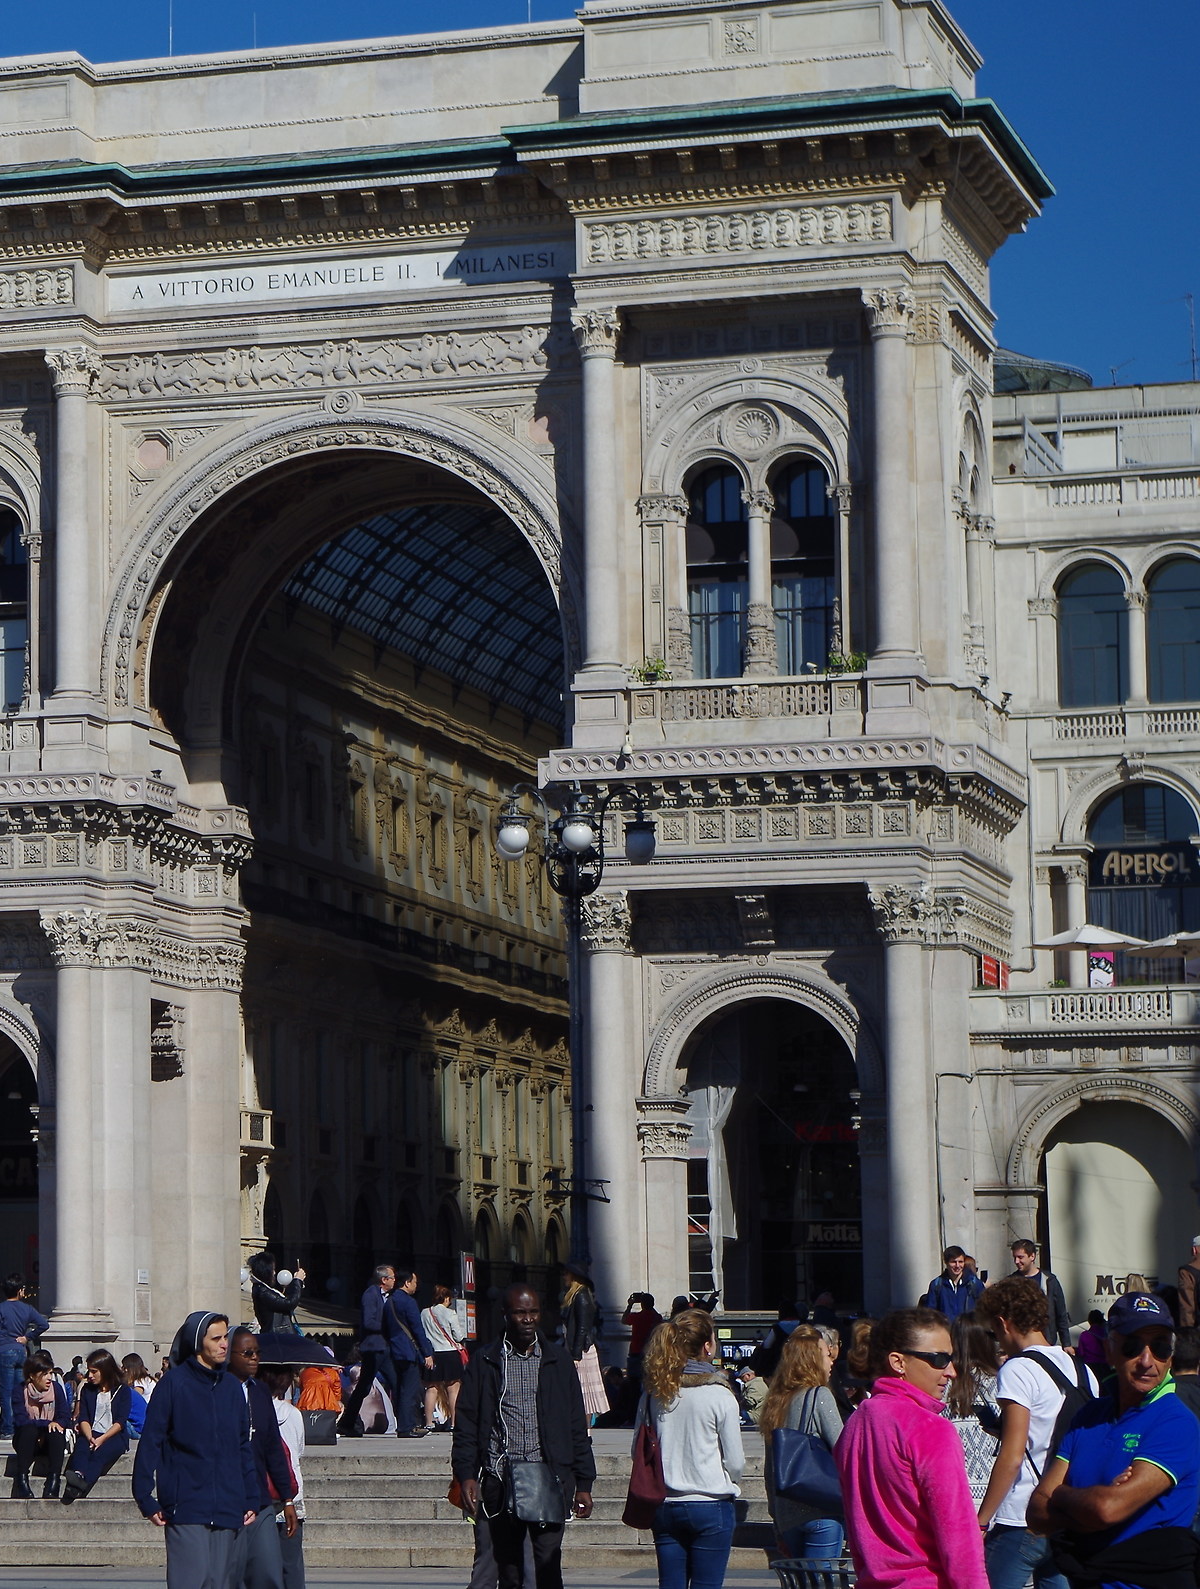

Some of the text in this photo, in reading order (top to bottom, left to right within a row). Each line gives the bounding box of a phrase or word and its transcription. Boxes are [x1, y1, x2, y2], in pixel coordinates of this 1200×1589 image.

[132, 285, 144, 299] A
[158, 276, 254, 297] VITTORIO
[268, 265, 384, 289] EMANUELE
[435, 261, 441, 277] I
[454, 251, 555, 275] MILANESI
[1102, 850, 1191, 876] APEROL
[1103, 874, 1191, 885] TERRAZZA
[807, 1224, 860, 1242] Motta
[465, 1261, 475, 1284] M
